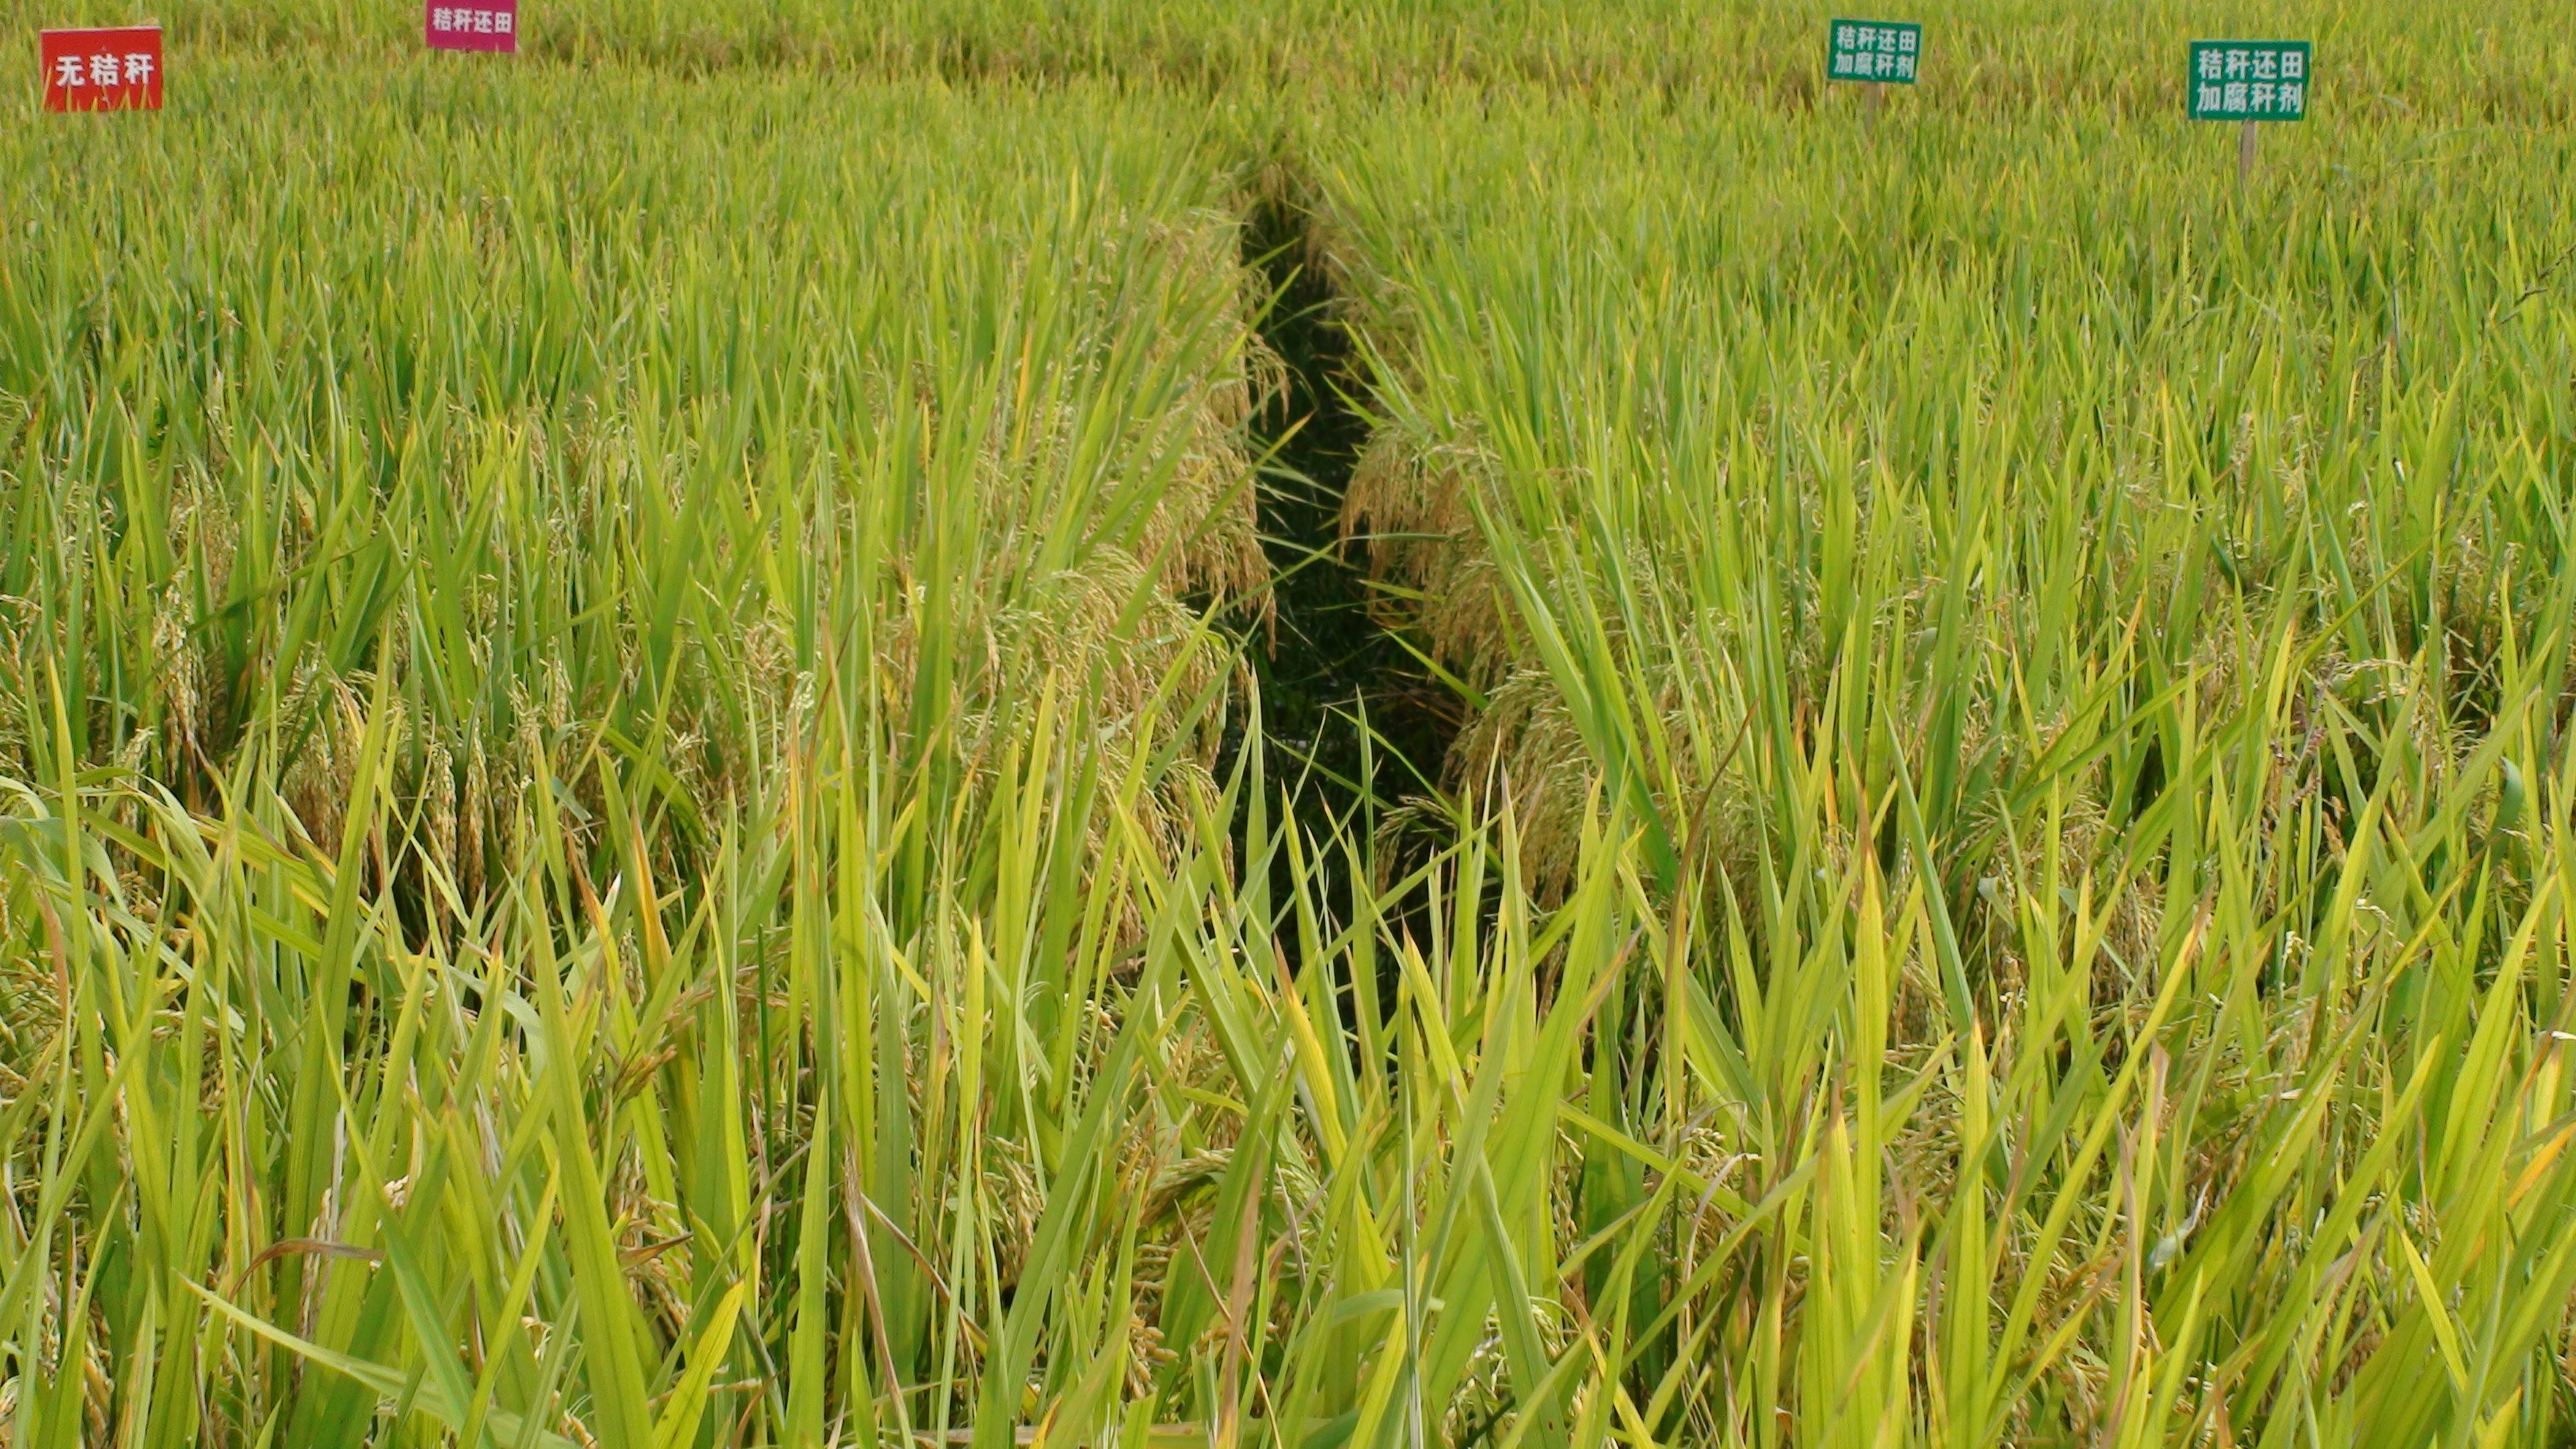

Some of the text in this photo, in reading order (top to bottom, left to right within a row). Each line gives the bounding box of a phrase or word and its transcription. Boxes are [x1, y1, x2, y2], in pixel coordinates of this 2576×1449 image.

[56, 53, 154, 87] 无秸秆
[2198, 48, 2304, 79] 秸秆还田
[2196, 81, 2303, 113] 加腐秆剂
